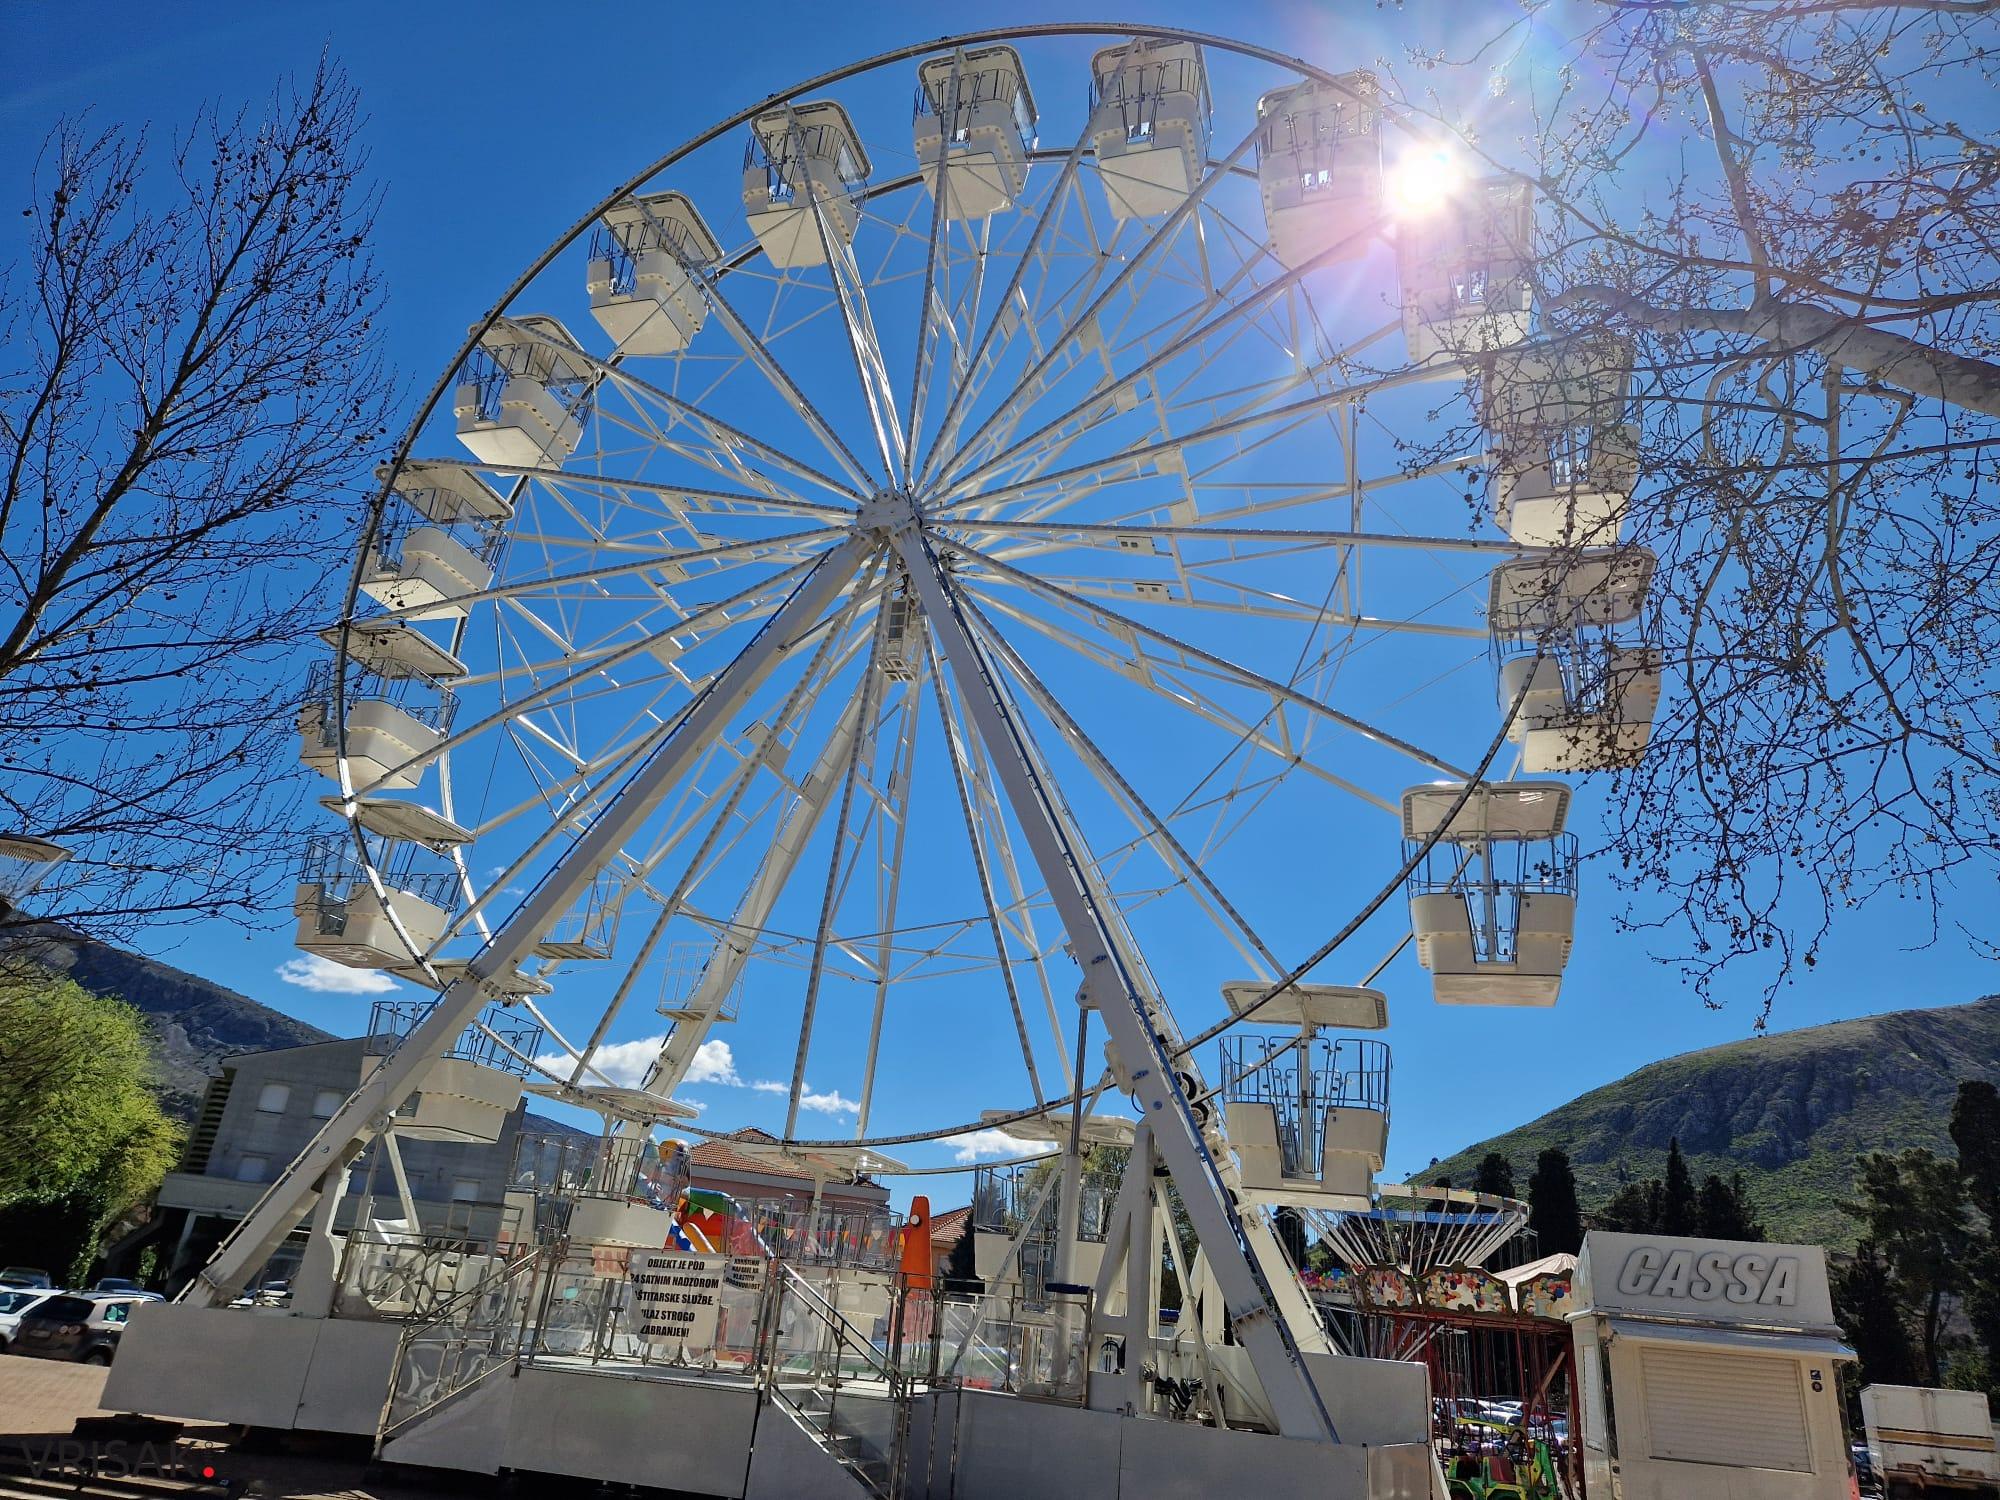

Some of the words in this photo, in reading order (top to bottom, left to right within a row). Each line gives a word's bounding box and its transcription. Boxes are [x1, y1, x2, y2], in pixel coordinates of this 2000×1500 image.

[647, 1258, 677, 1270] OBJEKT
[678, 1260, 687, 1270] JE
[687, 1261, 705, 1271] POD
[640, 1274, 671, 1285] SATNIM
[672, 1276, 720, 1289] NADZOROM
[1617, 1246, 1799, 1306] CASSA
[661, 1310, 695, 1322] STROGO
